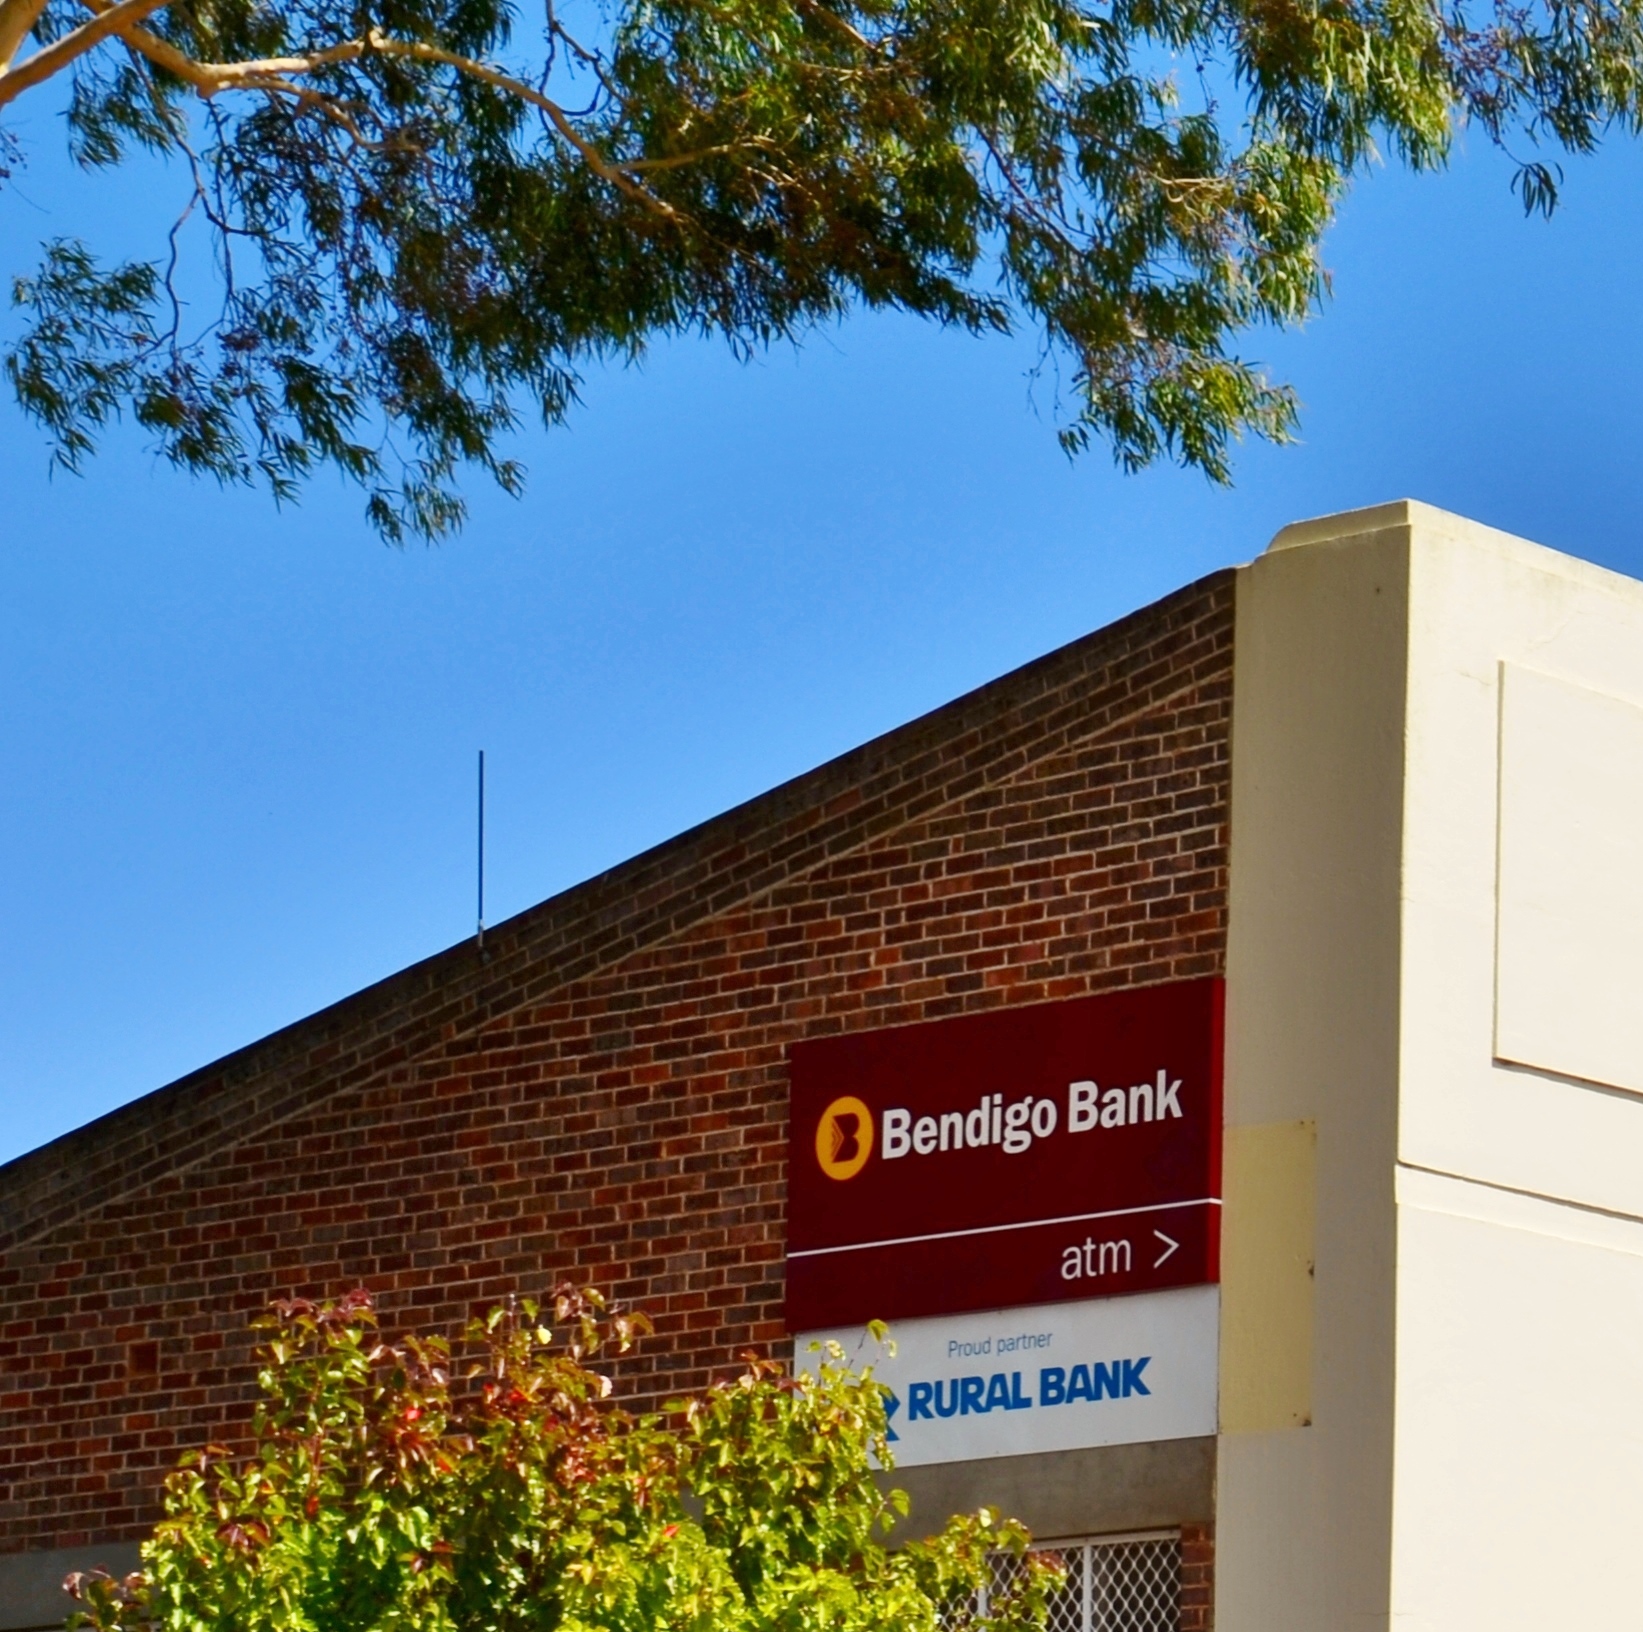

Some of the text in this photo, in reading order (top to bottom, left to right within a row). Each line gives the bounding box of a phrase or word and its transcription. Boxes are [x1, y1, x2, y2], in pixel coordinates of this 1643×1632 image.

[882, 1070, 1183, 1160] Bendigo Bank
[1061, 1237, 1131, 1280] atm
[948, 1332, 1053, 1358] Proud partner
[908, 1356, 1152, 1420] RURAL BANK
